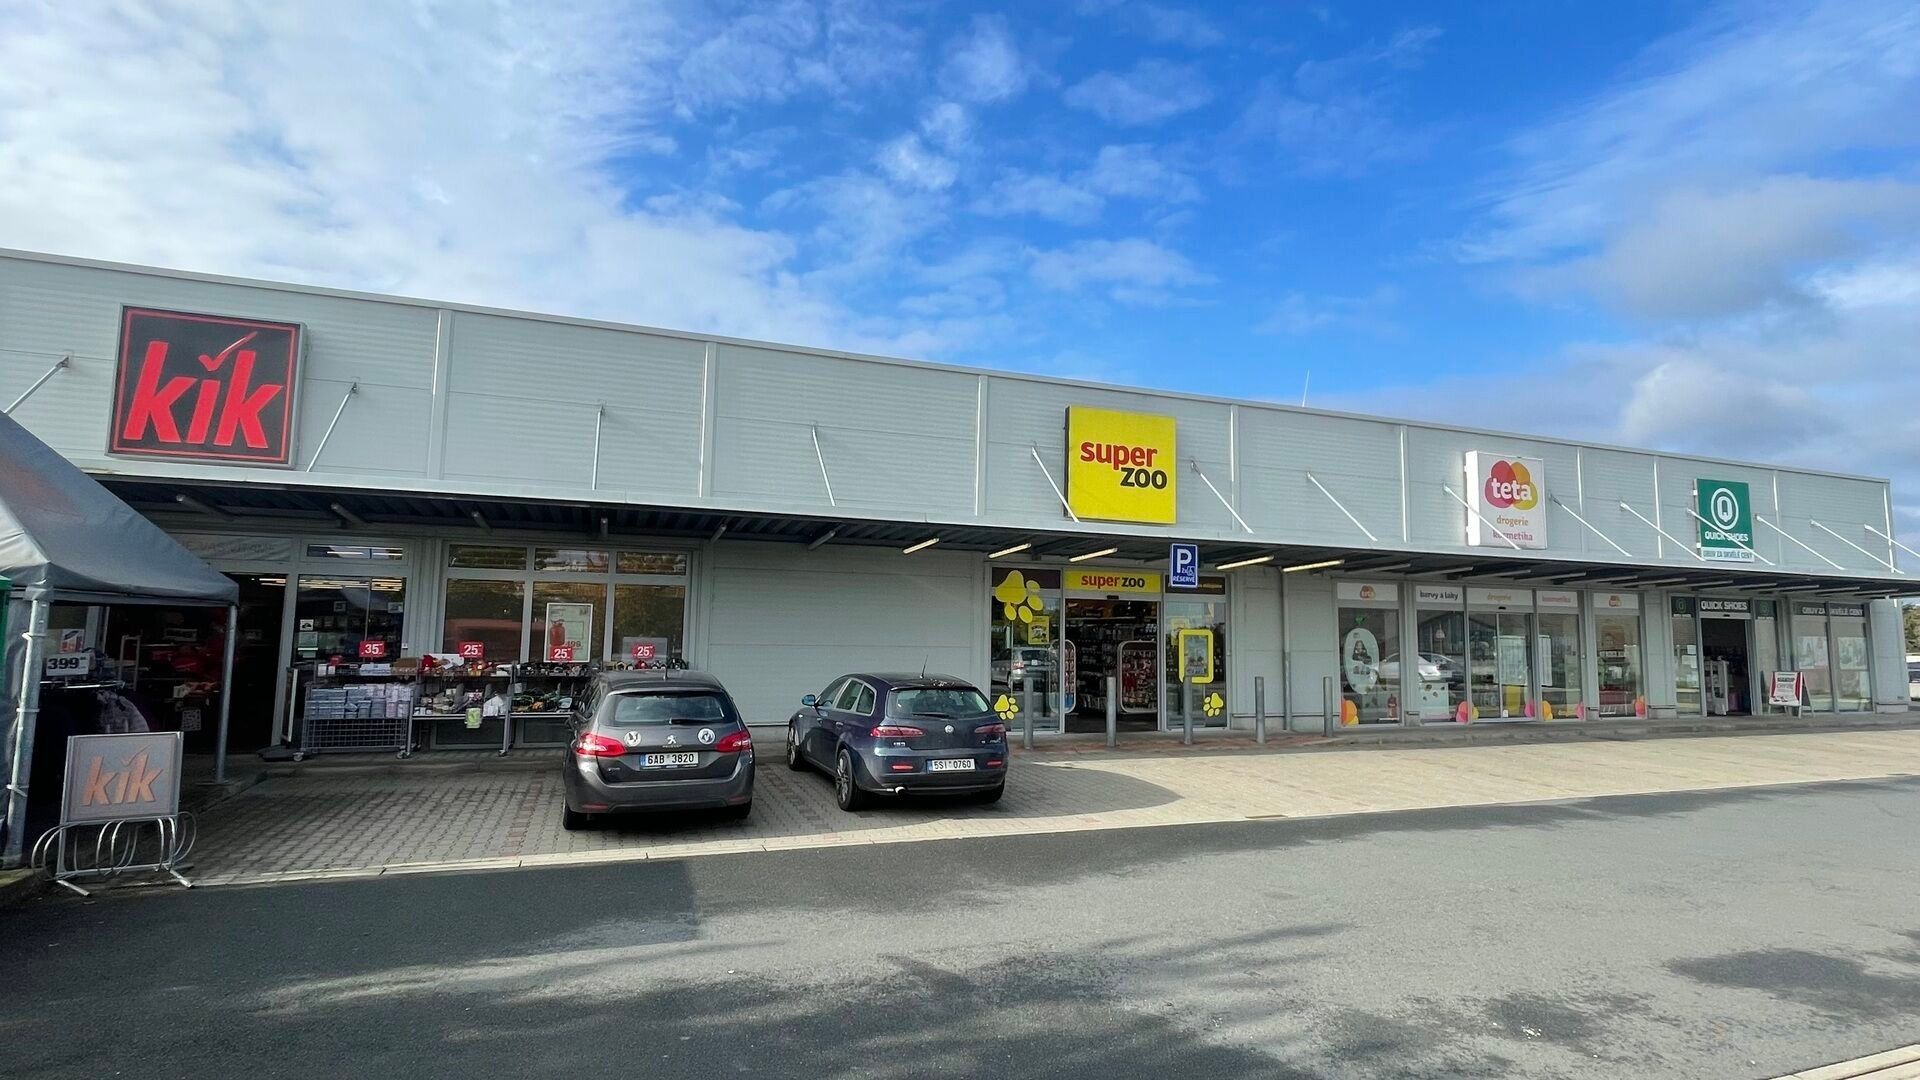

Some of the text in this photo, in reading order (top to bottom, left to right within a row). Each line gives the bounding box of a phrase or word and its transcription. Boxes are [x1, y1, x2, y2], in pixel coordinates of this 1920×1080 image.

[1080, 441, 1158, 471] super
[1120, 467, 1168, 490] zoo
[1491, 478, 1533, 501] teta
[1496, 515, 1529, 528] drogerie
[1704, 531, 1726, 541] QUICK
[1176, 548, 1193, 574] P
[1081, 575, 1145, 589] super zoo
[1419, 590, 1439, 600] barvy
[1444, 591, 1459, 601] laky
[1700, 600, 1748, 611] QUICK SHOES
[365, 643, 380, 655] 35
[463, 644, 479, 655] 25
[553, 648, 568, 659] 25
[638, 646, 650, 657] 25
[47, 657, 80, 670] 399
[647, 753, 695, 765] 6AB 3820
[933, 759, 972, 770] 5SI 0760
